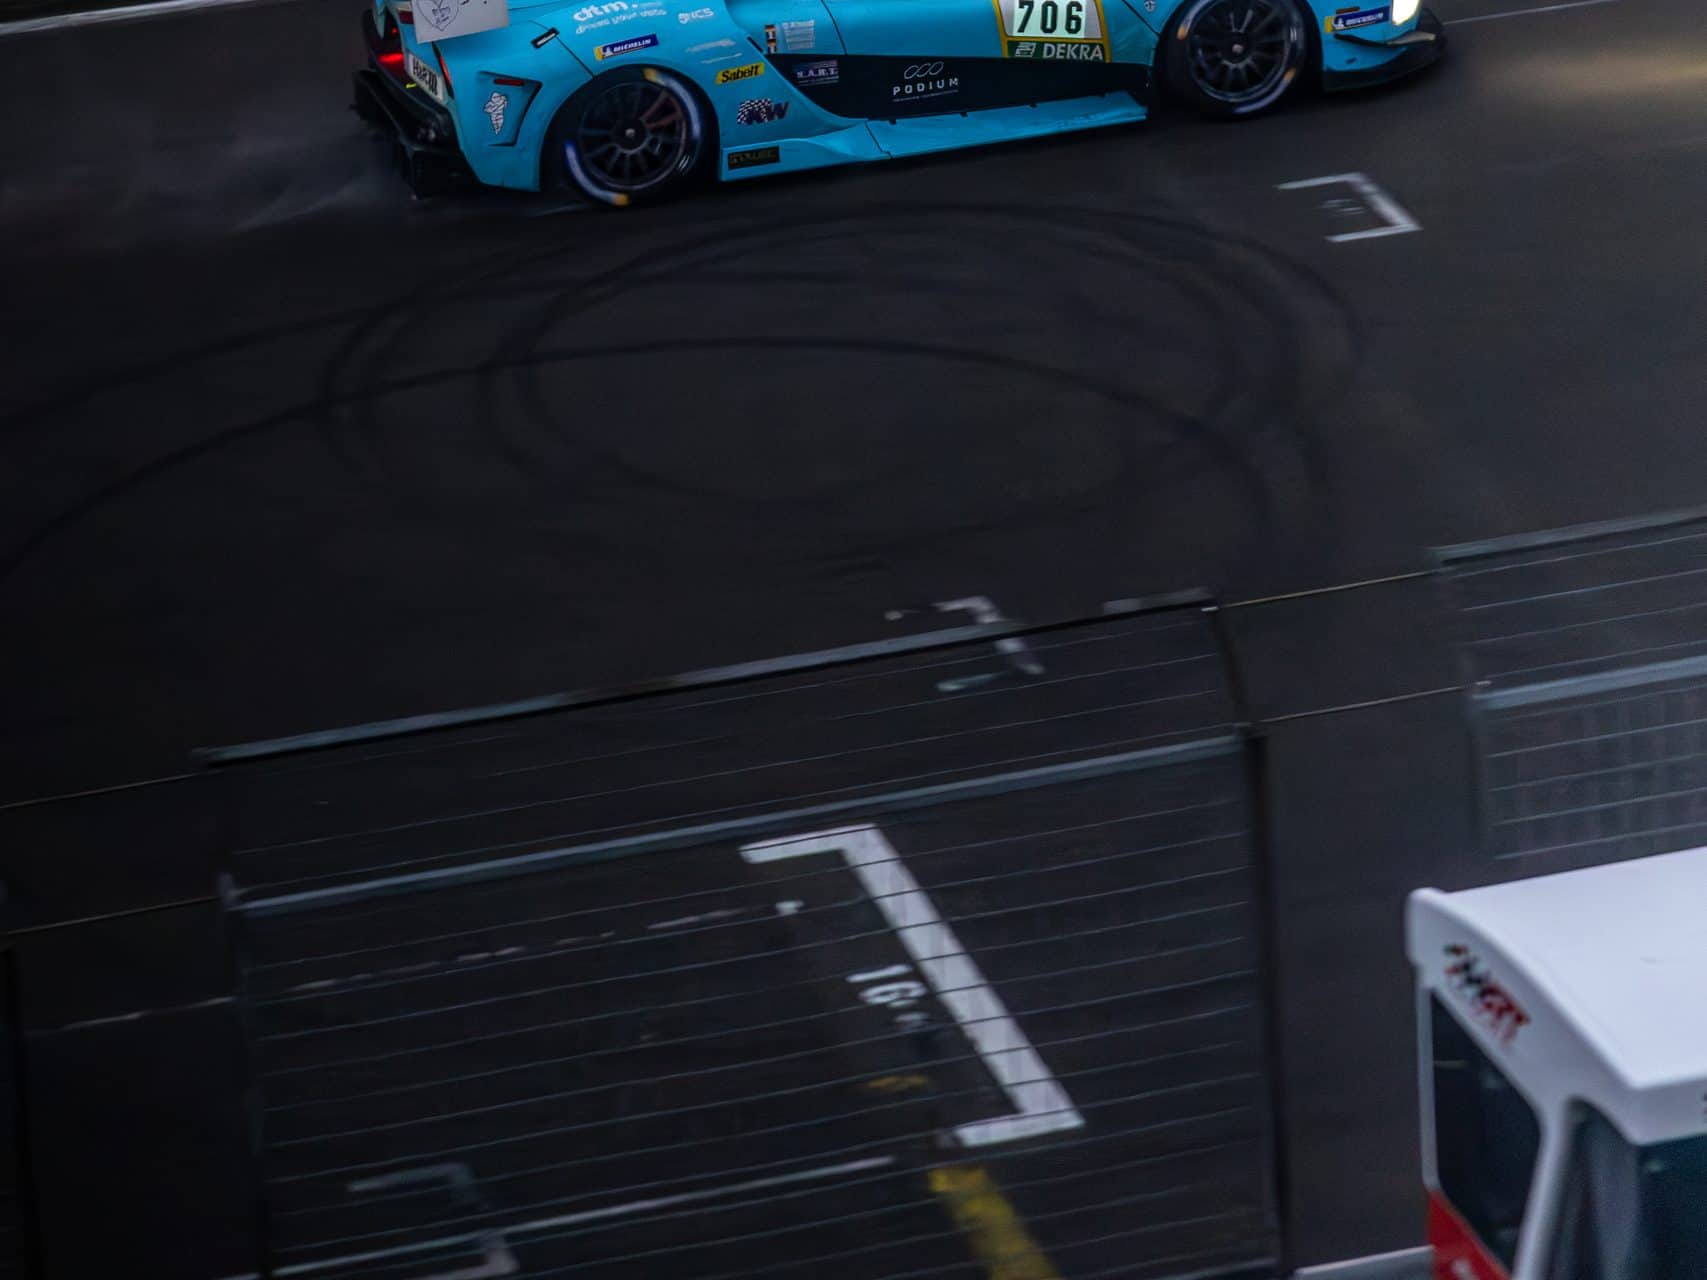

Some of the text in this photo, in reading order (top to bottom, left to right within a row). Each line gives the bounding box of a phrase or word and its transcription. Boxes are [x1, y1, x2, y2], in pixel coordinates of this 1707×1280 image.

[1017, 0, 1083, 35] 706
[613, 38, 652, 53] MICHELIN
[1042, 42, 1104, 62] DEKRA
[721, 64, 761, 83] Sabelt
[892, 77, 960, 97] PODIUM
